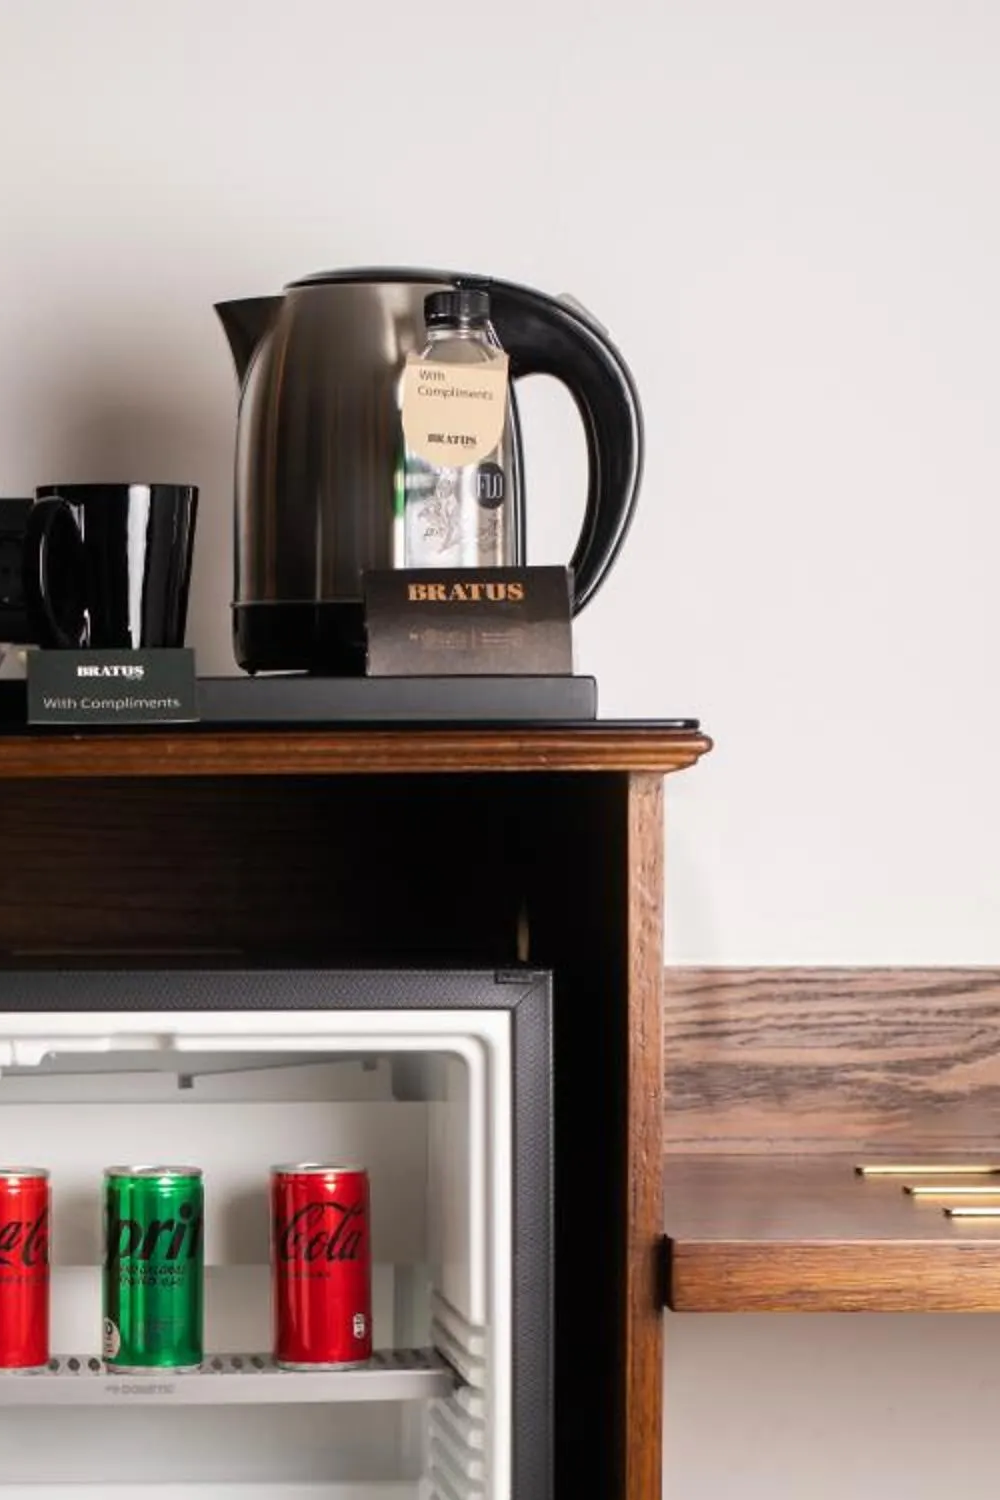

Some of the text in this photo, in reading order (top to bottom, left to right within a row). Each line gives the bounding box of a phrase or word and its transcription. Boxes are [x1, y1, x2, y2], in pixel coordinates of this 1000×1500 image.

[420, 366, 446, 381] With
[417, 386, 494, 401] Compliments
[427, 433, 478, 445] BRATUS
[407, 583, 524, 601] BRATUS
[76, 664, 145, 678] BRATUS
[43, 697, 181, 711] With Compliments
